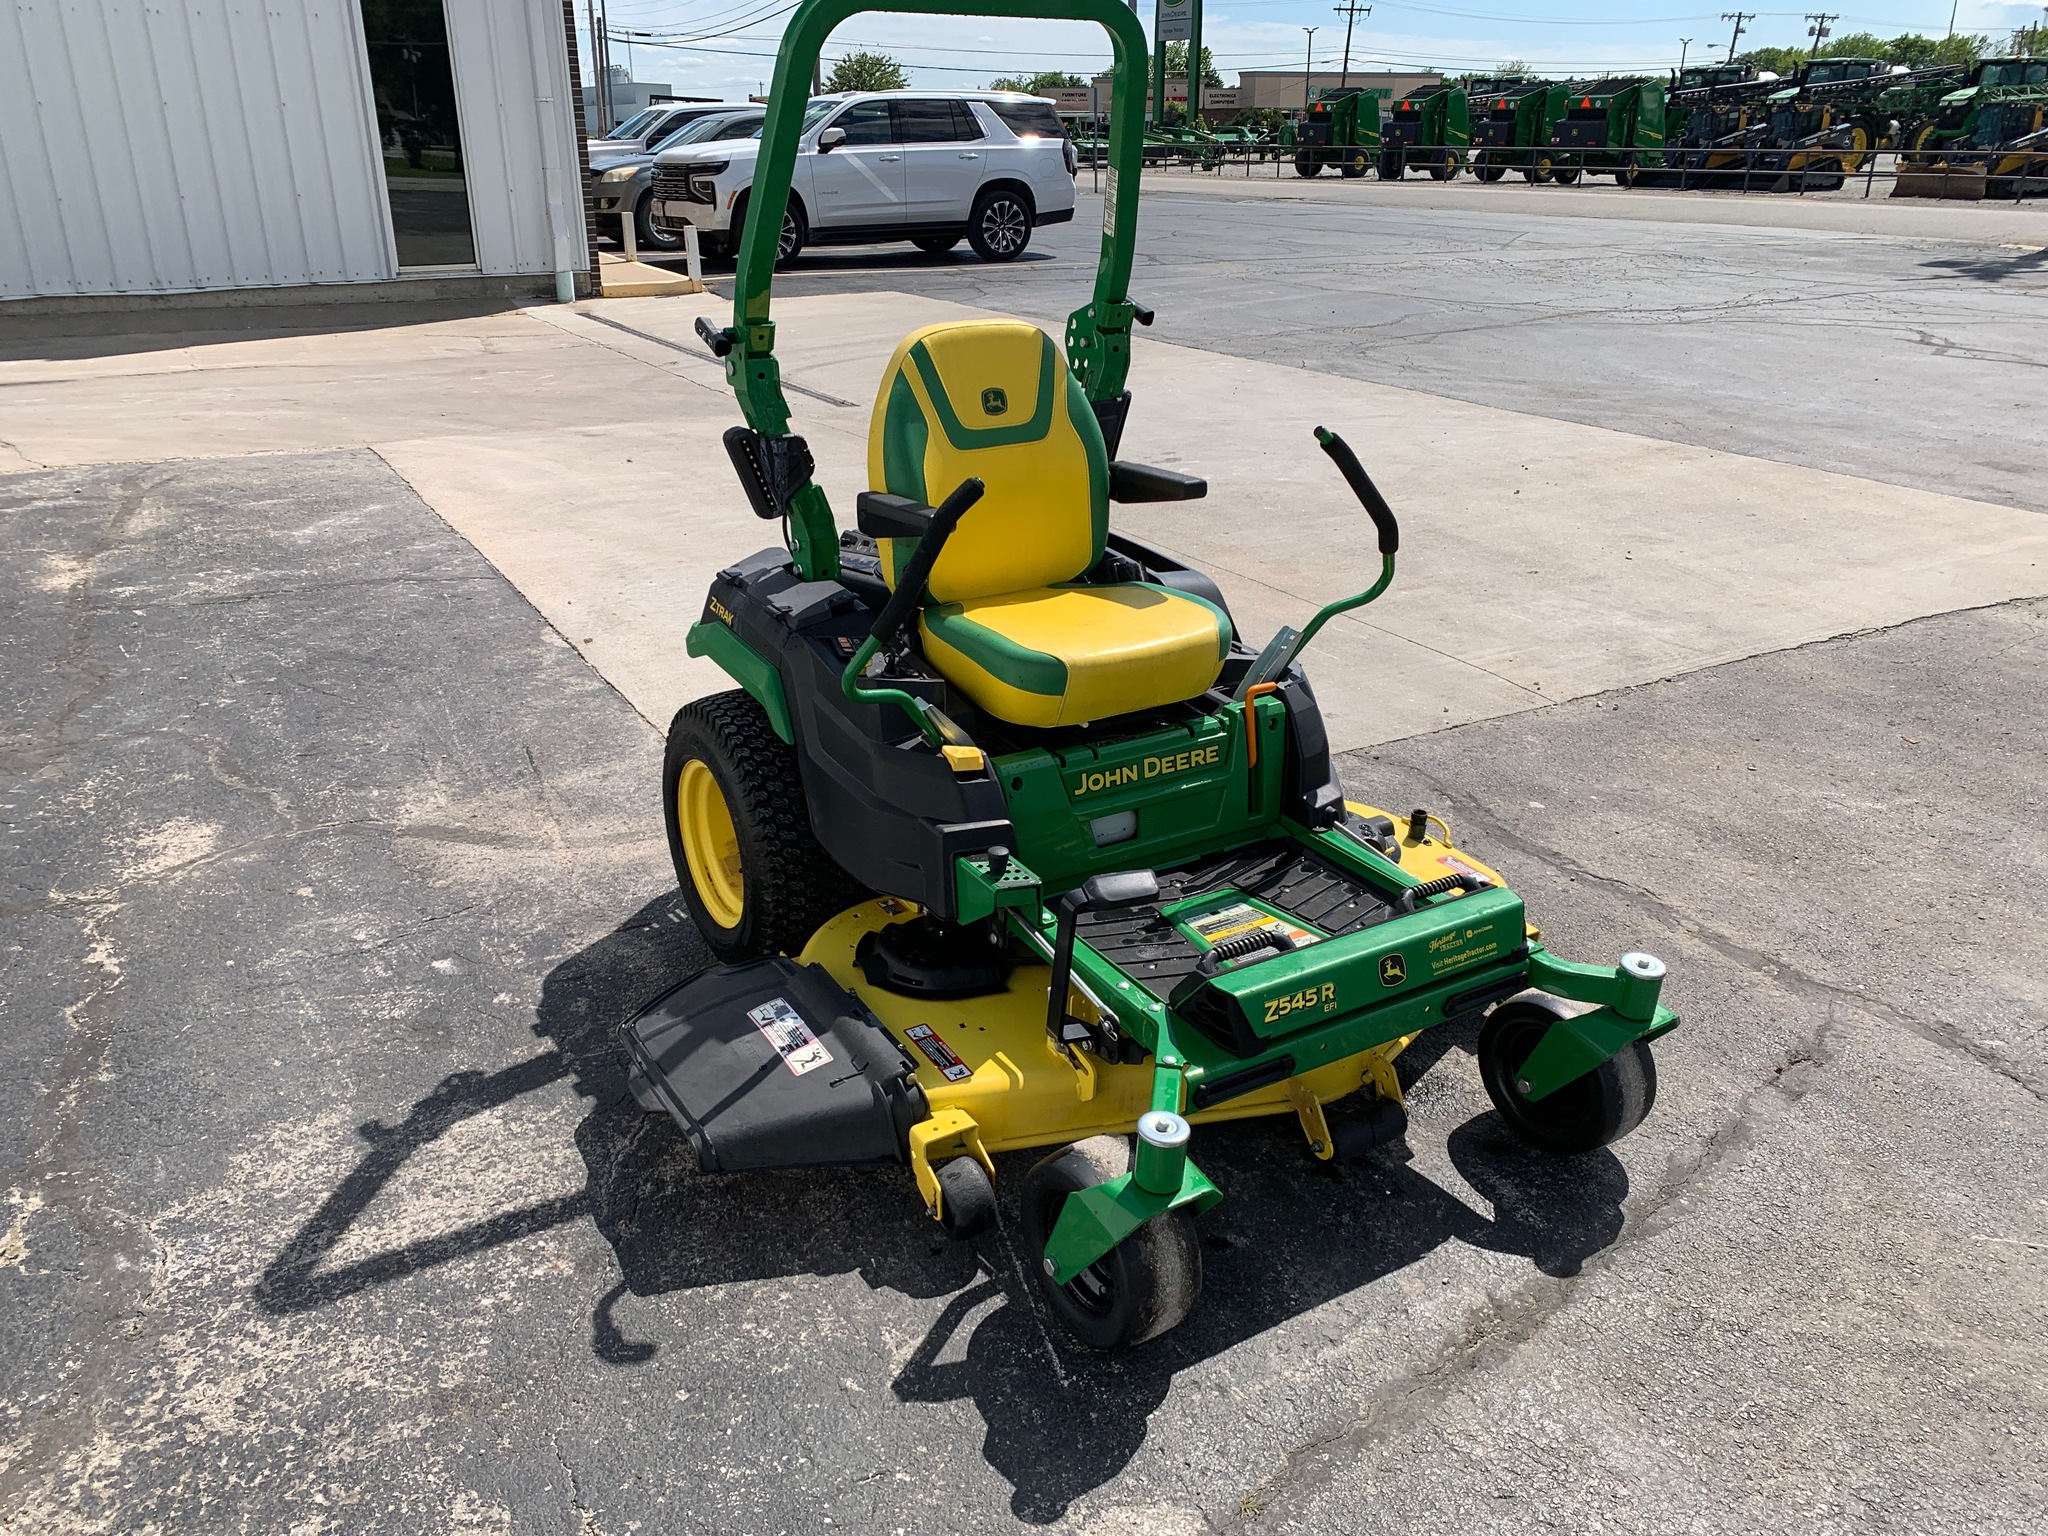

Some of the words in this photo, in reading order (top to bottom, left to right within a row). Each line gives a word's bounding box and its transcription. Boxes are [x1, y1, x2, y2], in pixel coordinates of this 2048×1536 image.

[709, 595, 735, 626] ZTRAK
[1074, 764, 1138, 796] JOHN
[1143, 745, 1220, 779] DEERE
[1431, 960, 1444, 970] Visit
[1443, 942, 1498, 966] HeritageTractor.com
[1264, 987, 1318, 1024] Z545
[1321, 983, 1336, 1002] R
[1324, 1001, 1338, 1013] EFI
